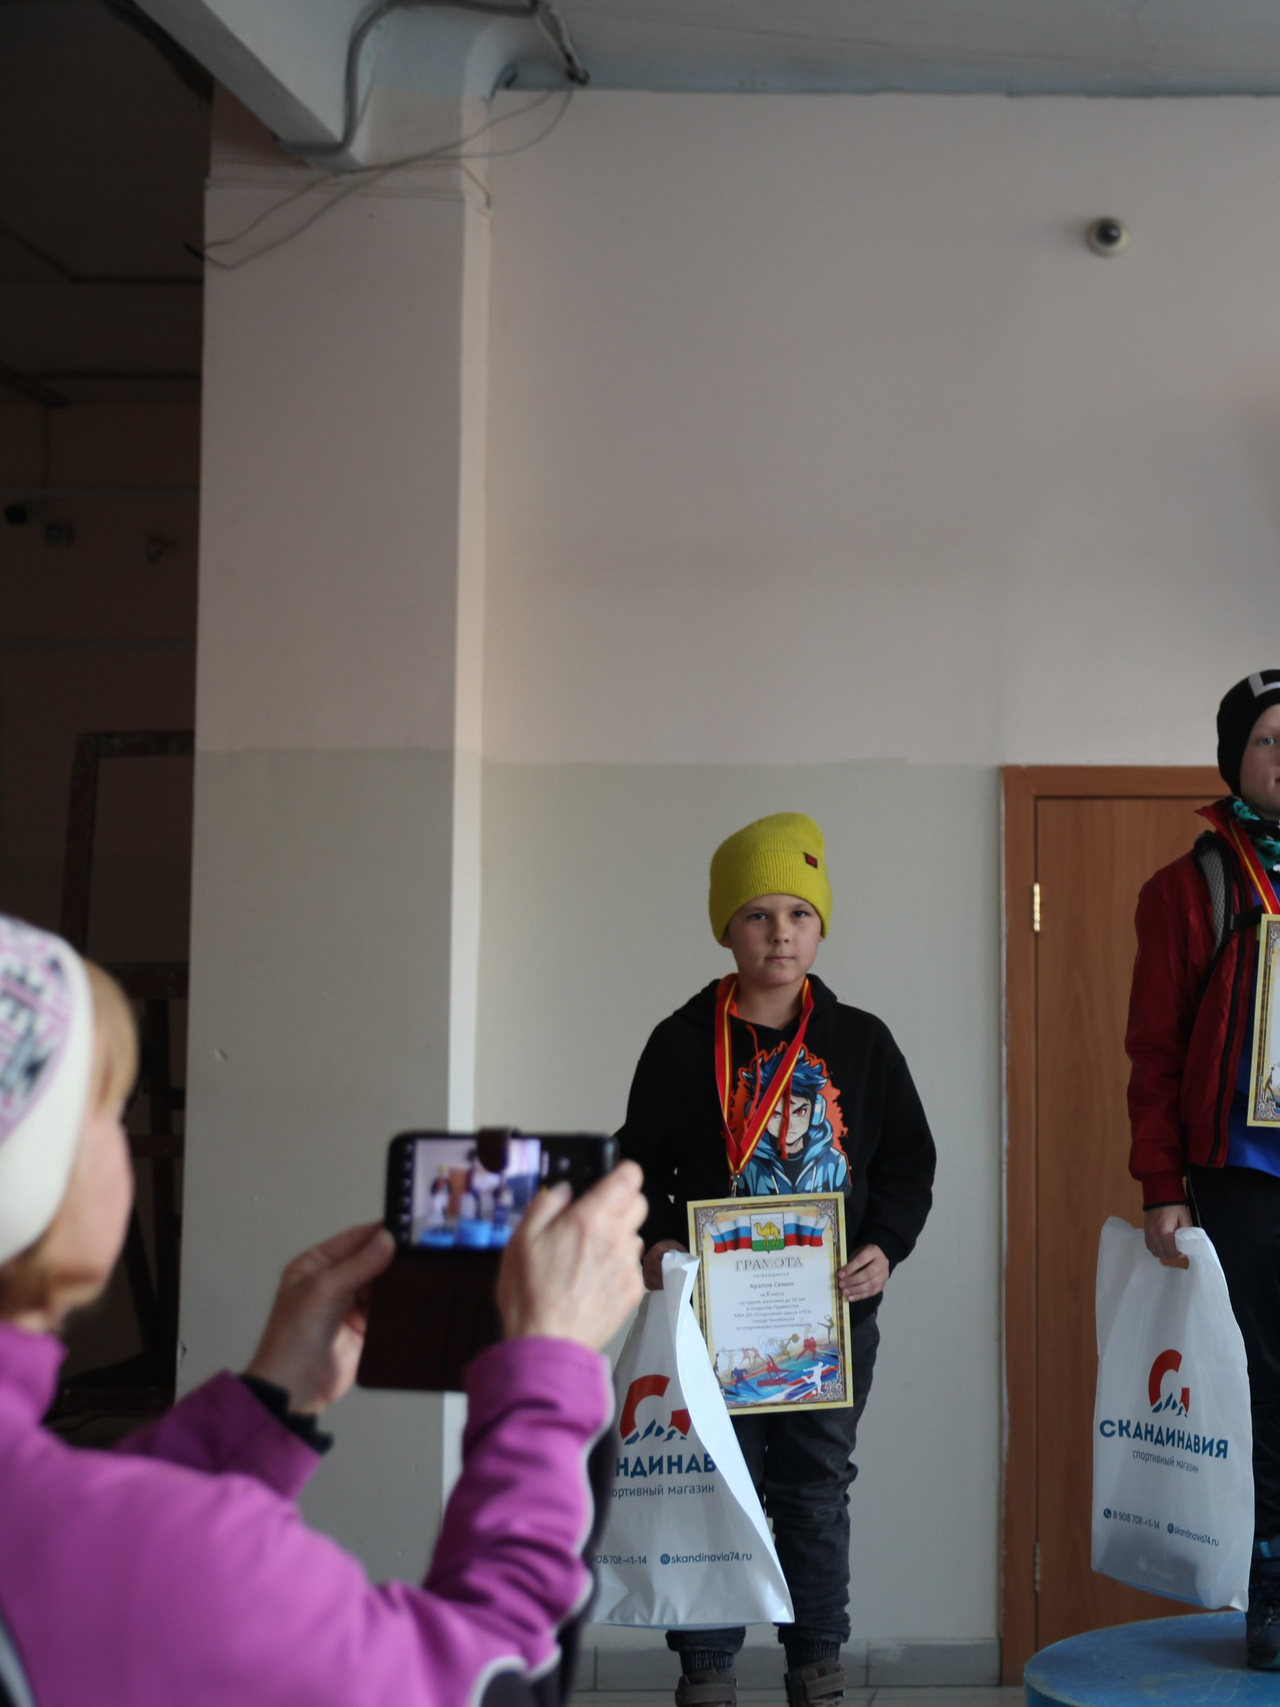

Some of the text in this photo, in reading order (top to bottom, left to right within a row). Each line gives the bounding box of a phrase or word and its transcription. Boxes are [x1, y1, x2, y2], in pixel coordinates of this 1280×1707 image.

[735, 1256, 803, 1270] ГРАМОТА
[1099, 1419, 1228, 1459] СКАНДИНАВИЯ
[616, 1454, 717, 1478] НДИНАВ
[1132, 1450, 1199, 1474] спортивный магазин
[611, 1484, 714, 1500] ортивный магазин
[1113, 1510, 1118, 1520] 8
[1118, 1512, 1130, 1523] 908
[671, 1552, 752, 1564] skandinavia74.ru
